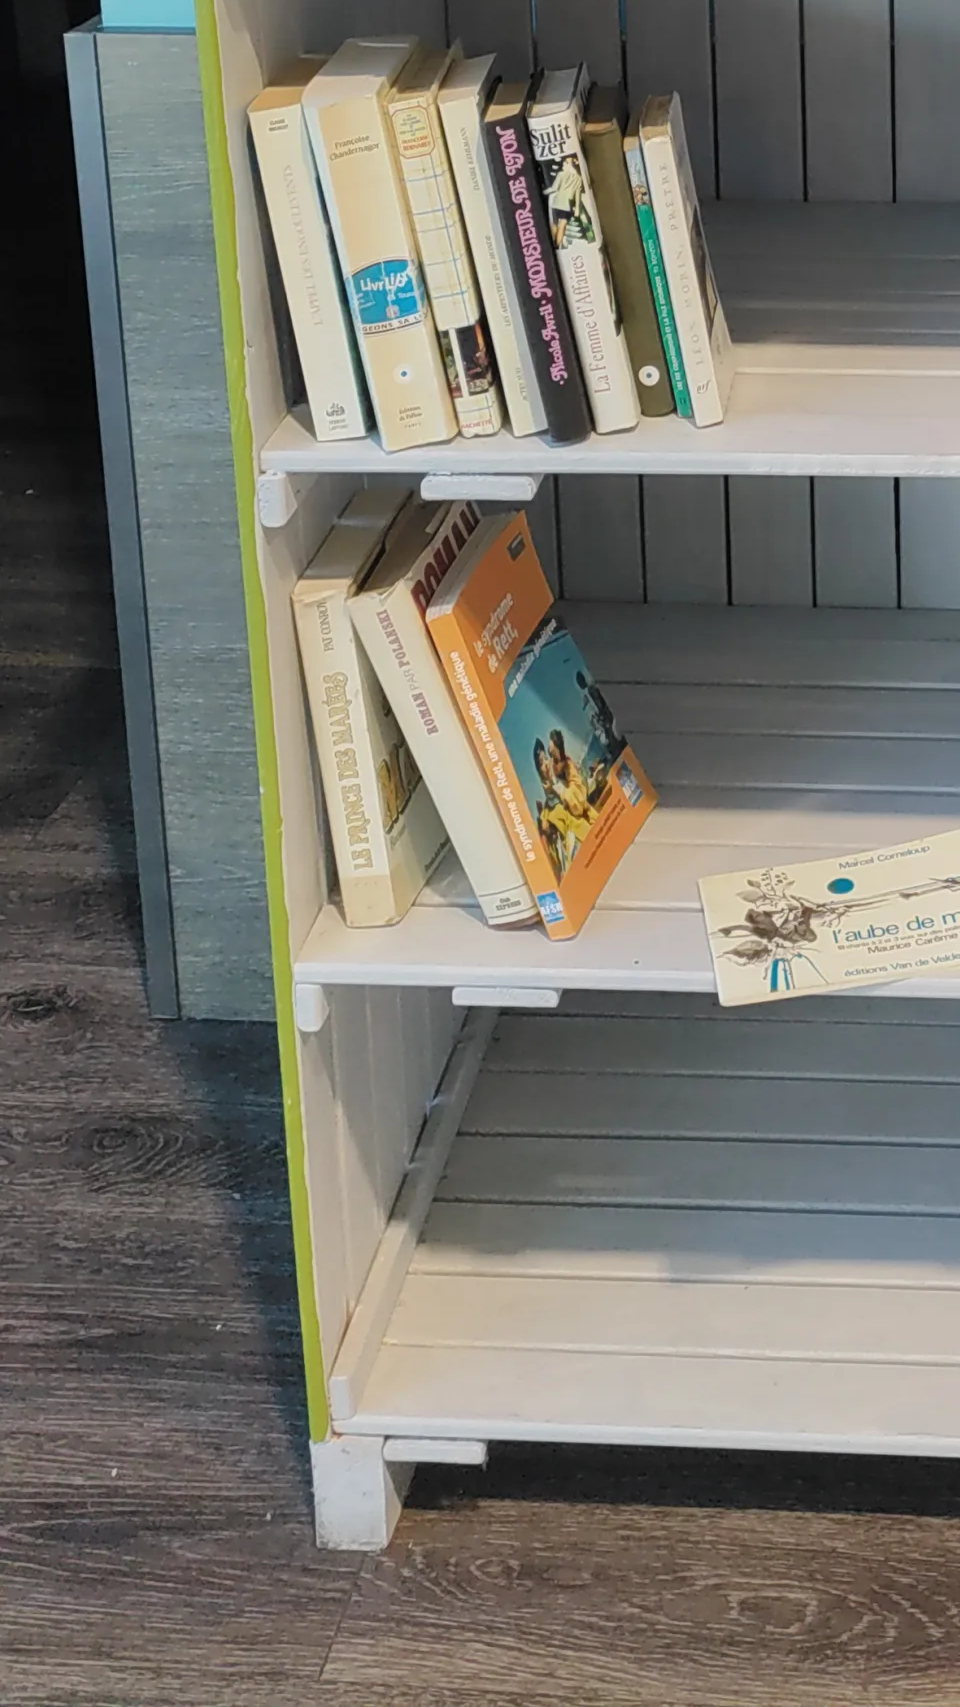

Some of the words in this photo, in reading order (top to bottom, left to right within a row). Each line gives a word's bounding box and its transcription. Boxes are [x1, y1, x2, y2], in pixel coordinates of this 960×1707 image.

[494, 119, 526, 175] LYON
[507, 175, 529, 203] DE
[511, 198, 552, 300] MONSIEUR
[566, 252, 595, 318] d'Affaires
[580, 320, 606, 372] Femme
[591, 374, 611, 394] La
[321, 635, 334, 651] PAT
[376, 608, 410, 669] POLANSKI
[402, 668, 420, 692] PAR
[411, 690, 439, 735] ROMAN
[832, 924, 899, 943] l'aube
[906, 916, 935, 930] de
[844, 965, 888, 977] éditions
[890, 961, 912, 971] Van
[915, 958, 929, 967] de
[931, 952, 960, 964] Velde
